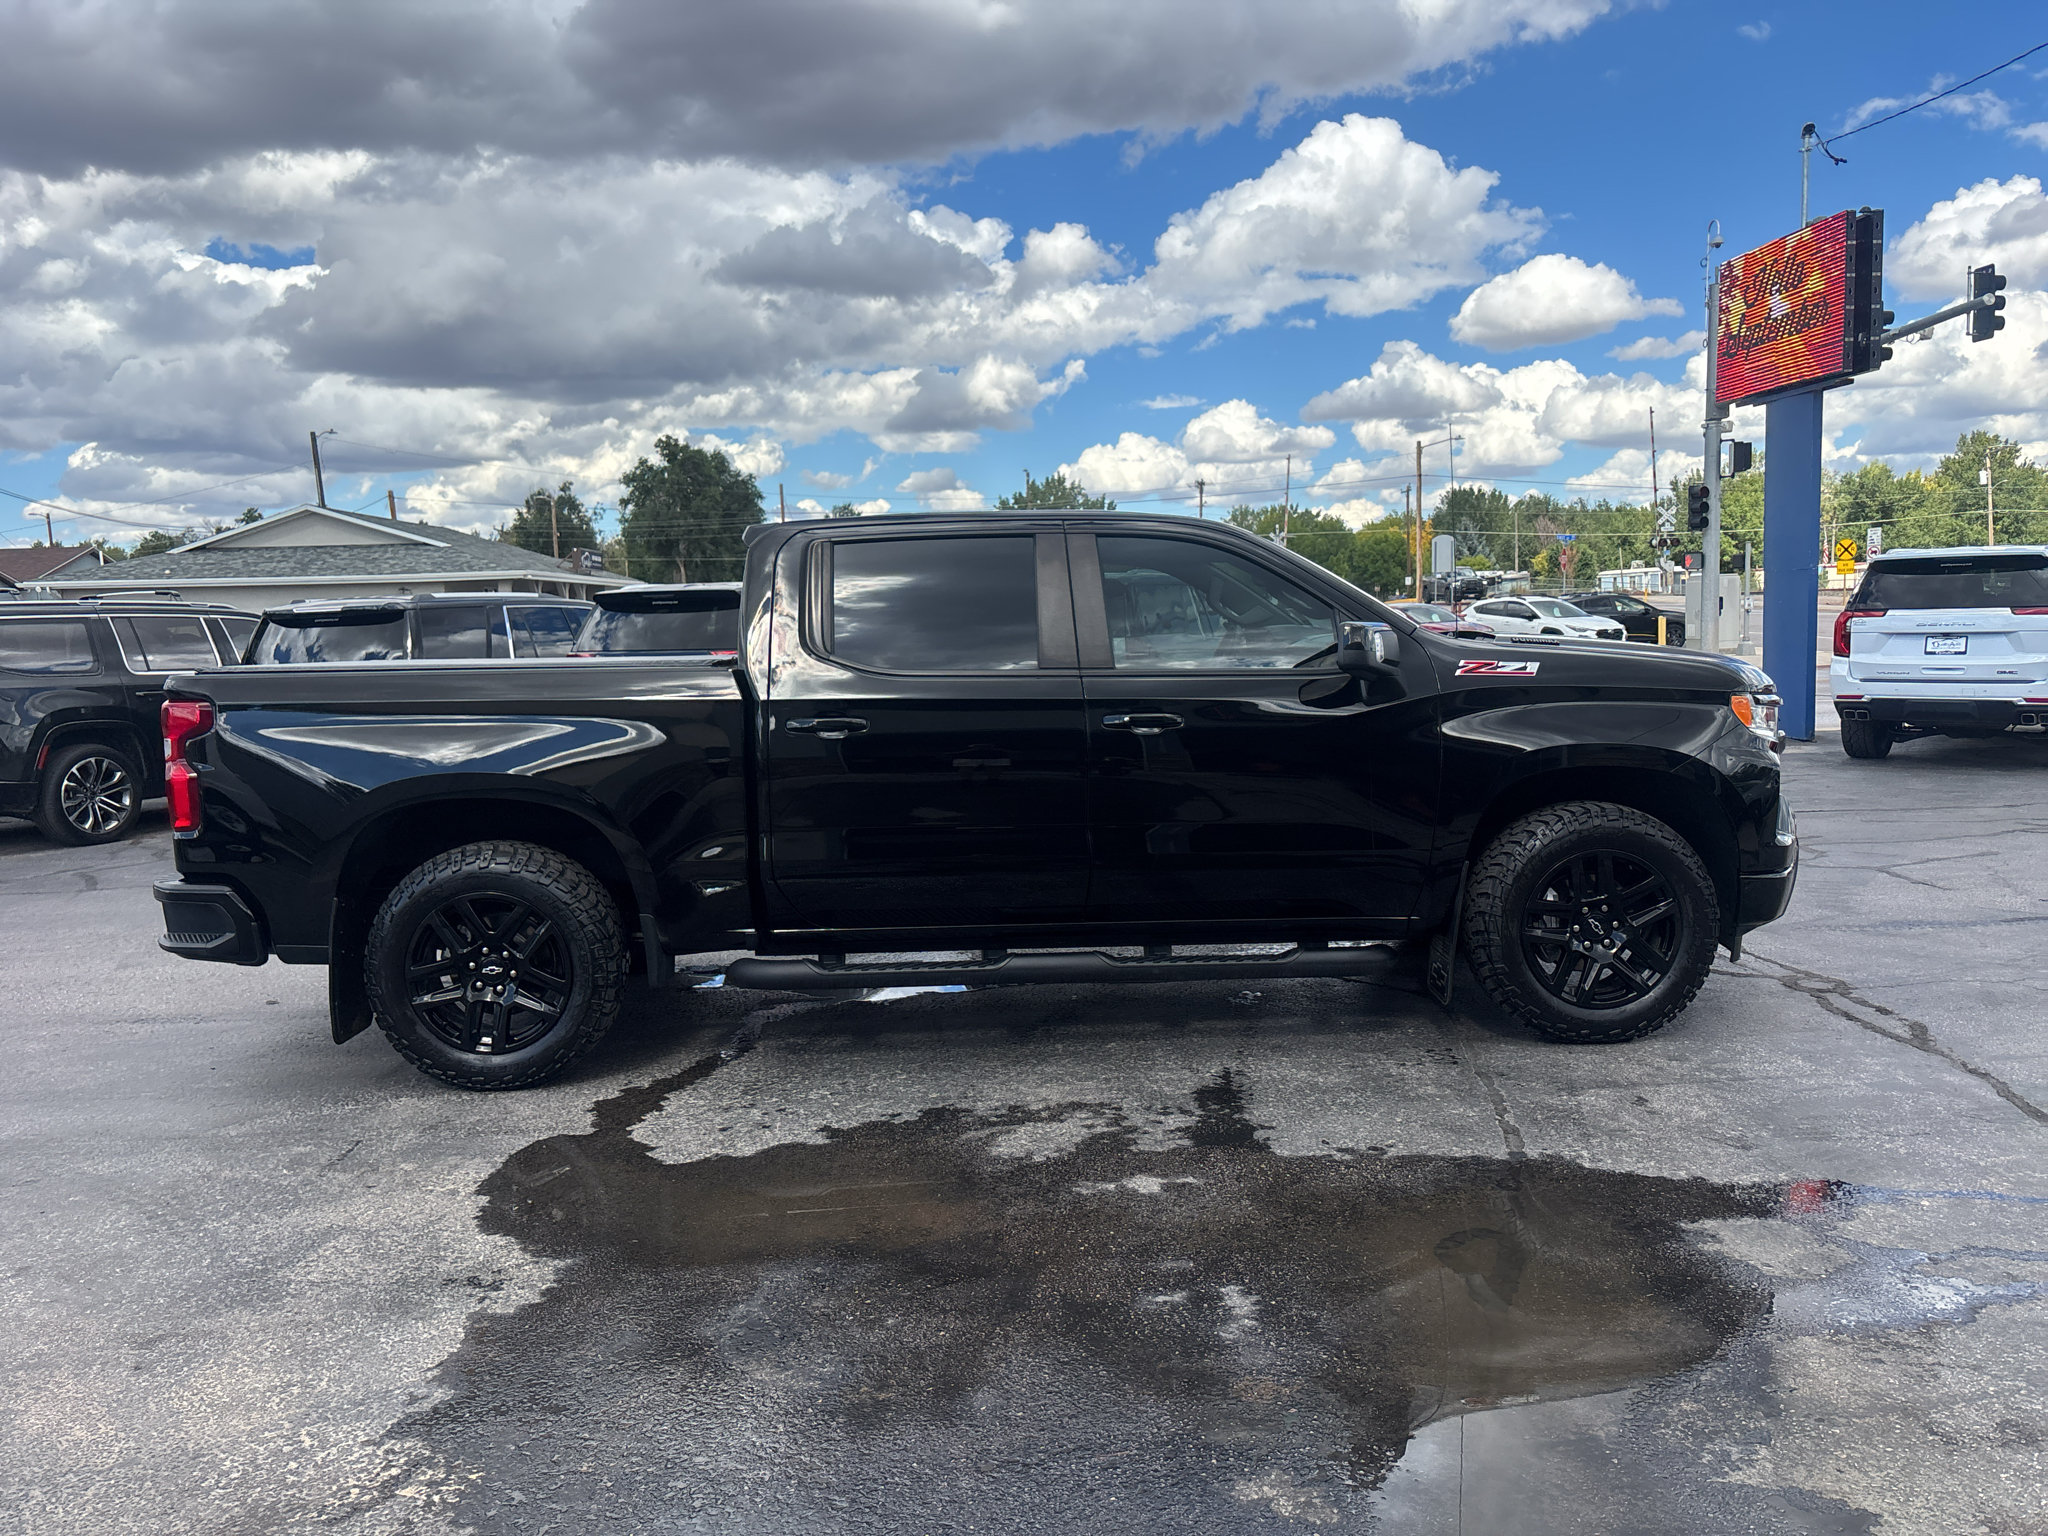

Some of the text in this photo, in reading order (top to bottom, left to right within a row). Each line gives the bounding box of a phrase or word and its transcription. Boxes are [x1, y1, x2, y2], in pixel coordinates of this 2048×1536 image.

[1744, 253, 1807, 308] Hello
[1720, 295, 1832, 361] September
[1454, 659, 1541, 677] Z71
